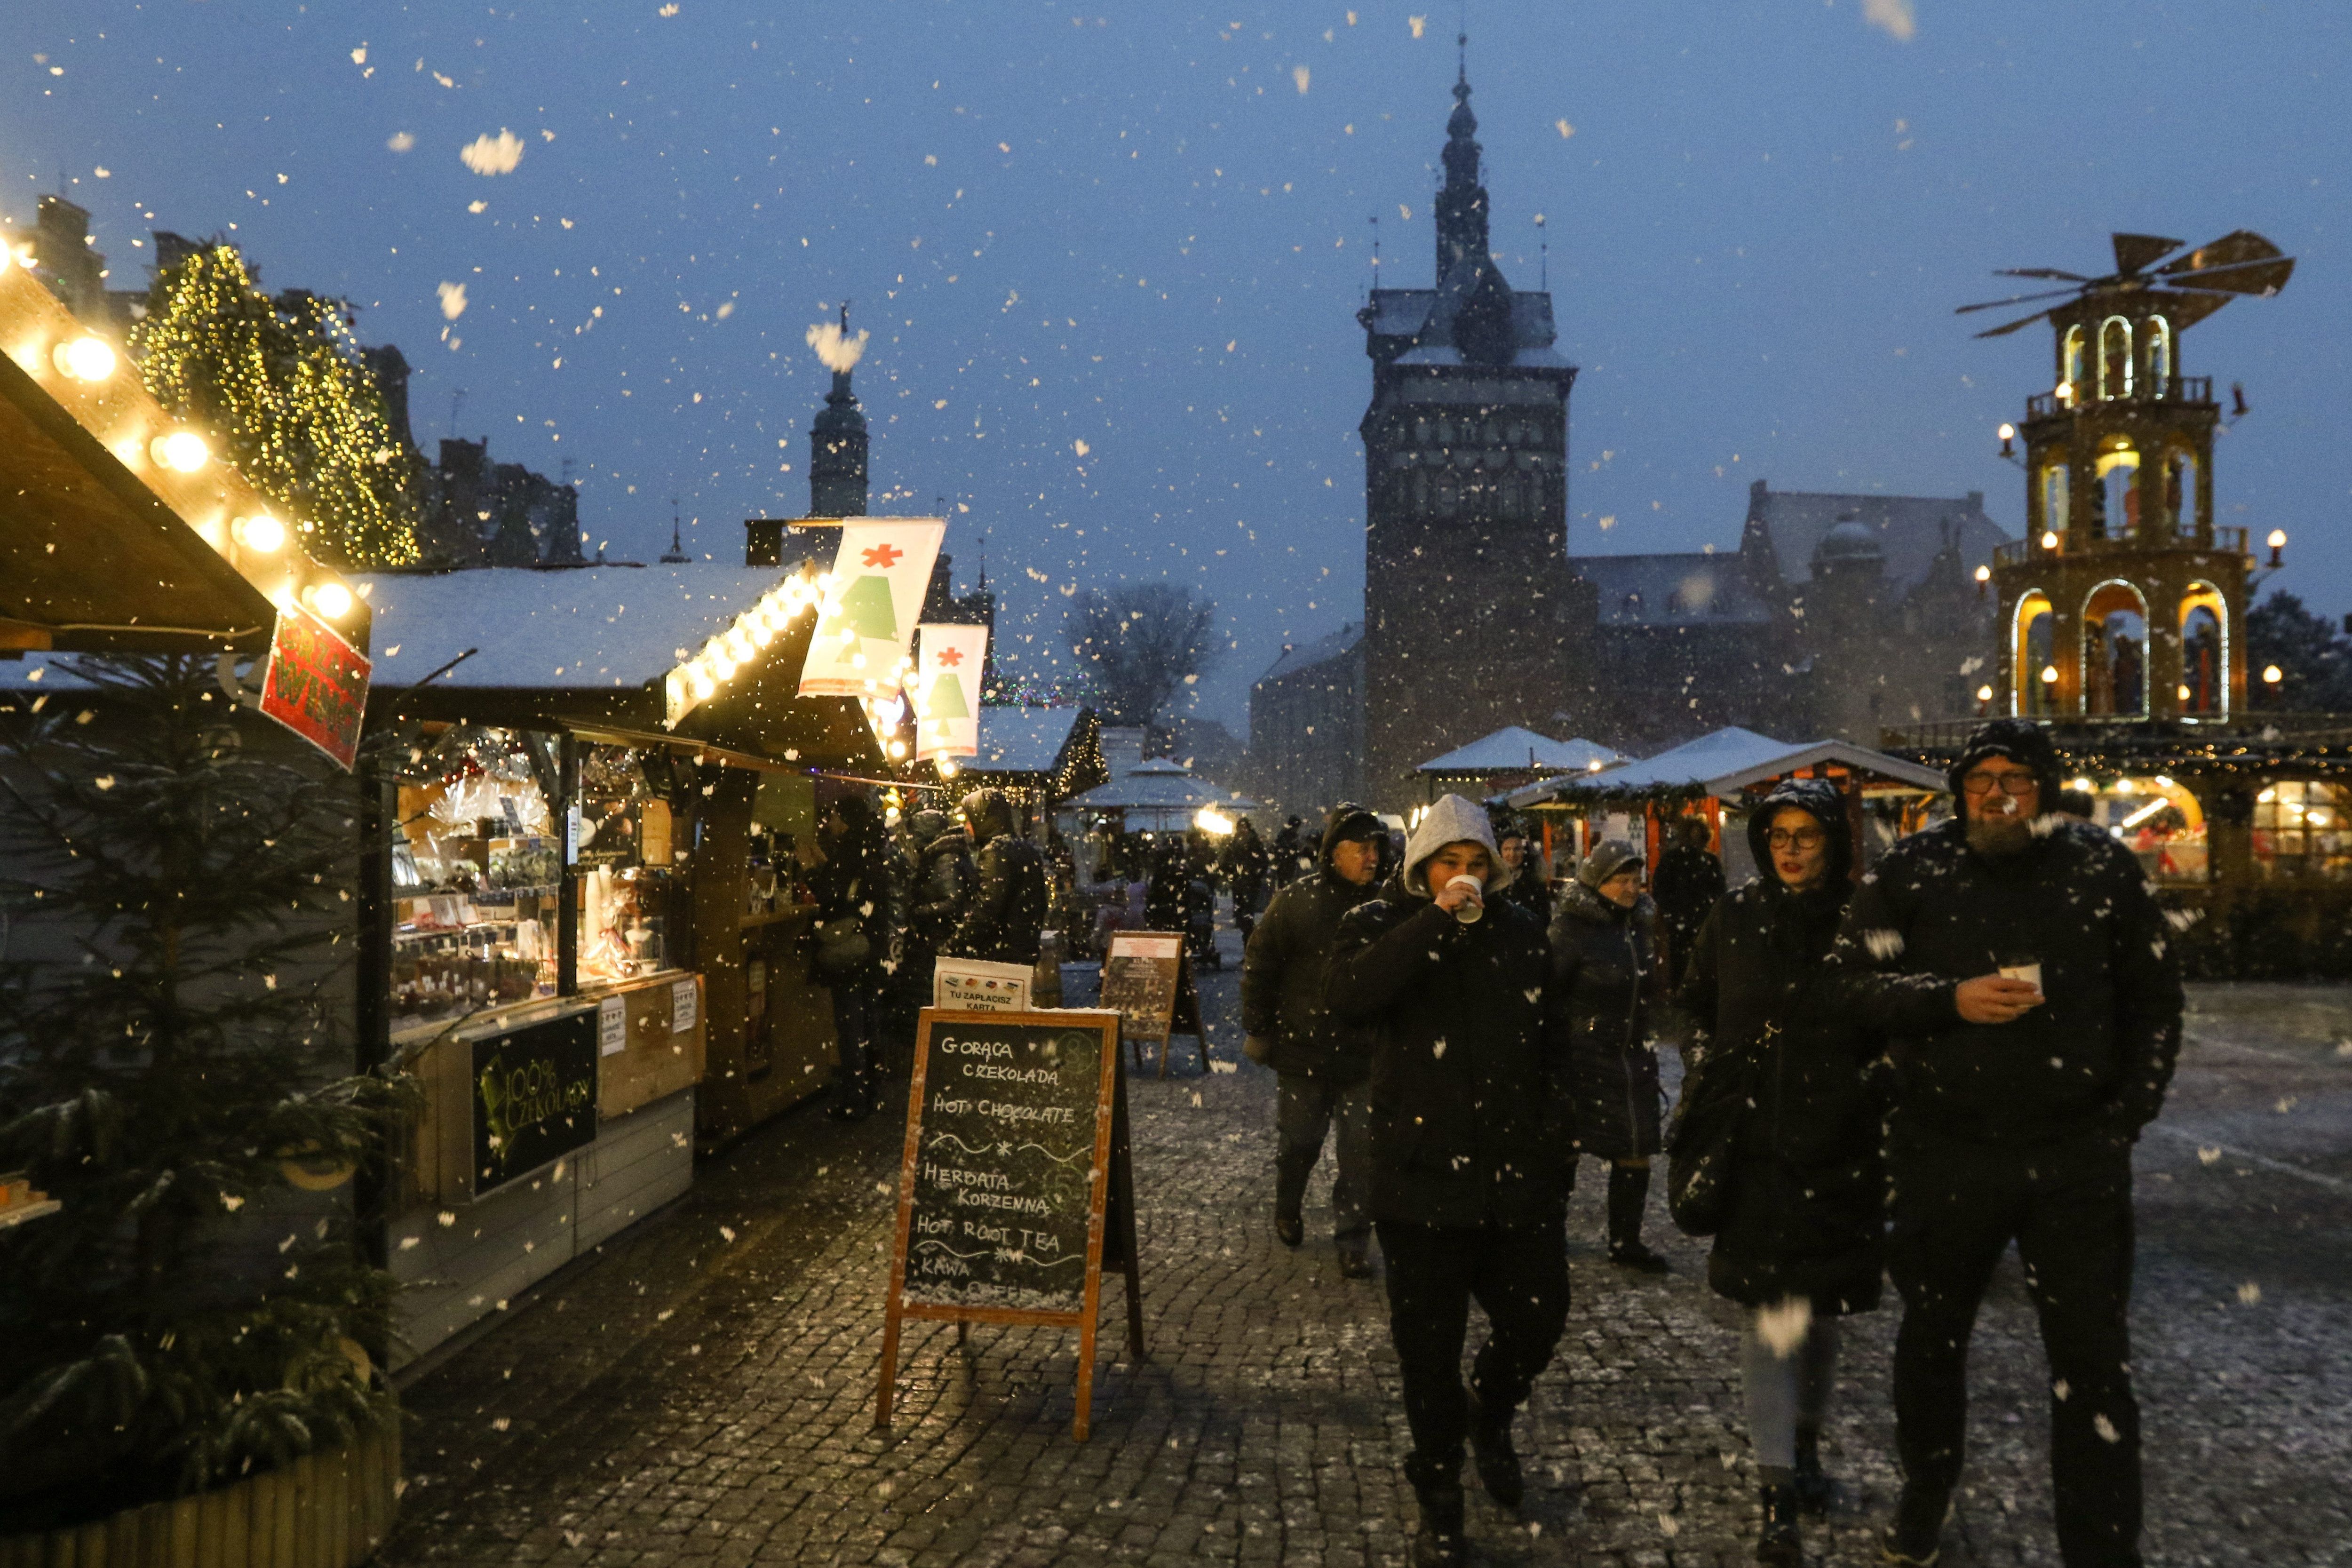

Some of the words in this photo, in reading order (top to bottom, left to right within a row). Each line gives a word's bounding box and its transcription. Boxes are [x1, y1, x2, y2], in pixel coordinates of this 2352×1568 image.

[276, 655, 359, 745] WINO
[964, 993, 1011, 1004] ZAPŁACISZ
[942, 1037, 1013, 1062] GORĄCA
[934, 1094, 967, 1114] HOT
[978, 1100, 1075, 1123] CHOCOLATE
[924, 1162, 1010, 1191] HERBATA
[917, 1214, 953, 1234] HOT
[964, 1221, 1011, 1246] ROOT
[1020, 1229, 1060, 1252] TEA
[922, 1257, 970, 1276] KAWA
